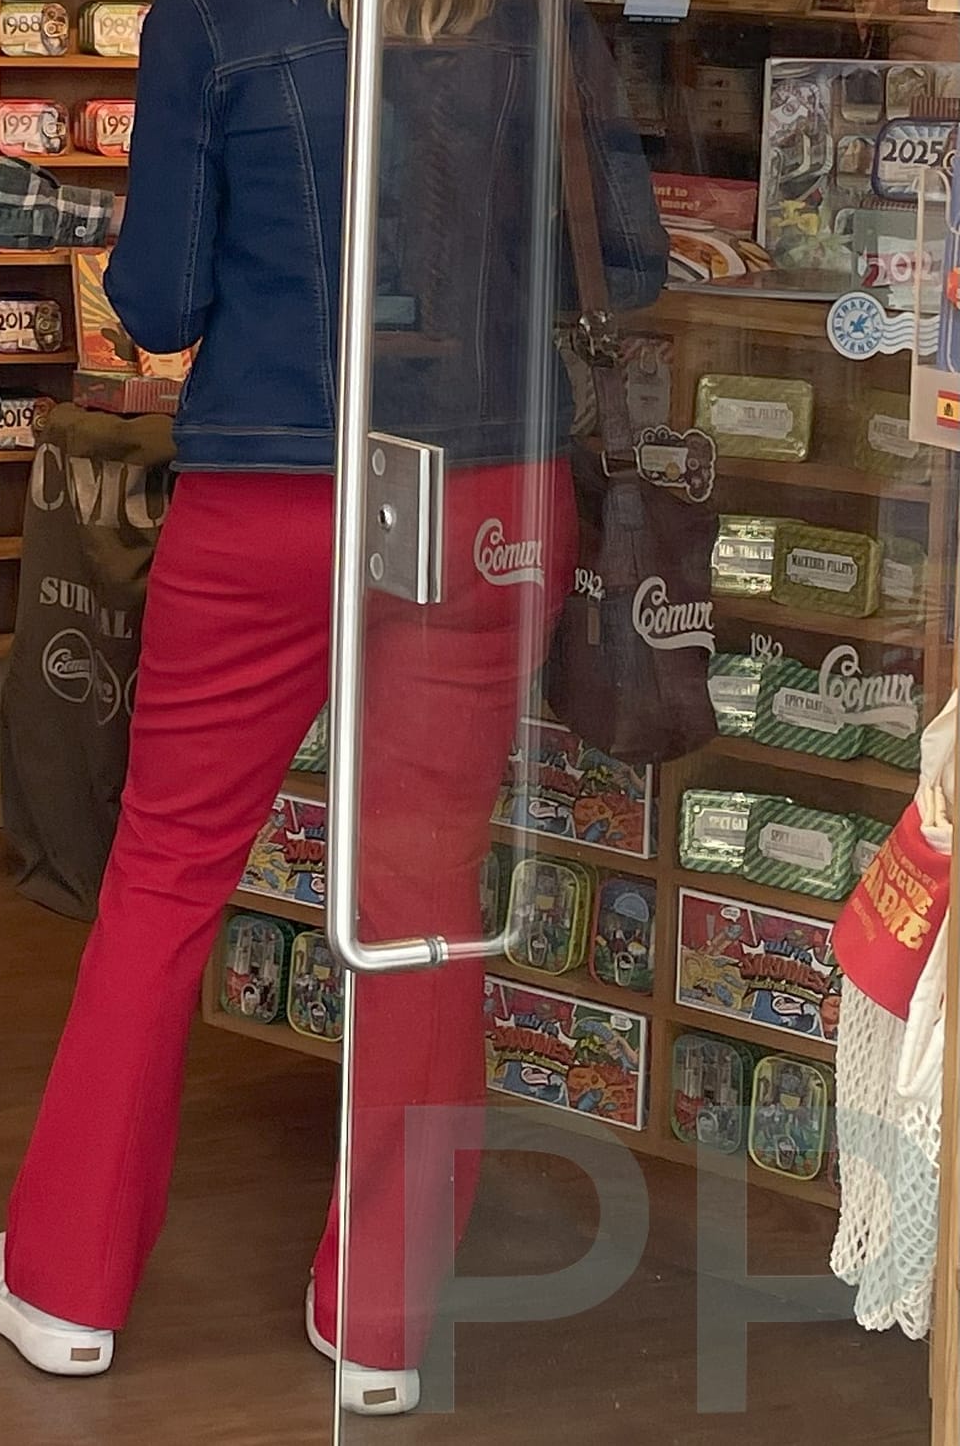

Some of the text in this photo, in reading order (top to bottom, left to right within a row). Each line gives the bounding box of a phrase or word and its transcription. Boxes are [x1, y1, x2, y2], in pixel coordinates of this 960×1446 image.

[2, 12, 41, 34] 1988
[101, 115, 132, 137] 199
[882, 138, 943, 167] 2025
[836, 300, 879, 318] TRAVEL
[473, 517, 545, 589] Comur
[632, 575, 715, 655] Comur
[819, 644, 918, 726] Comur
